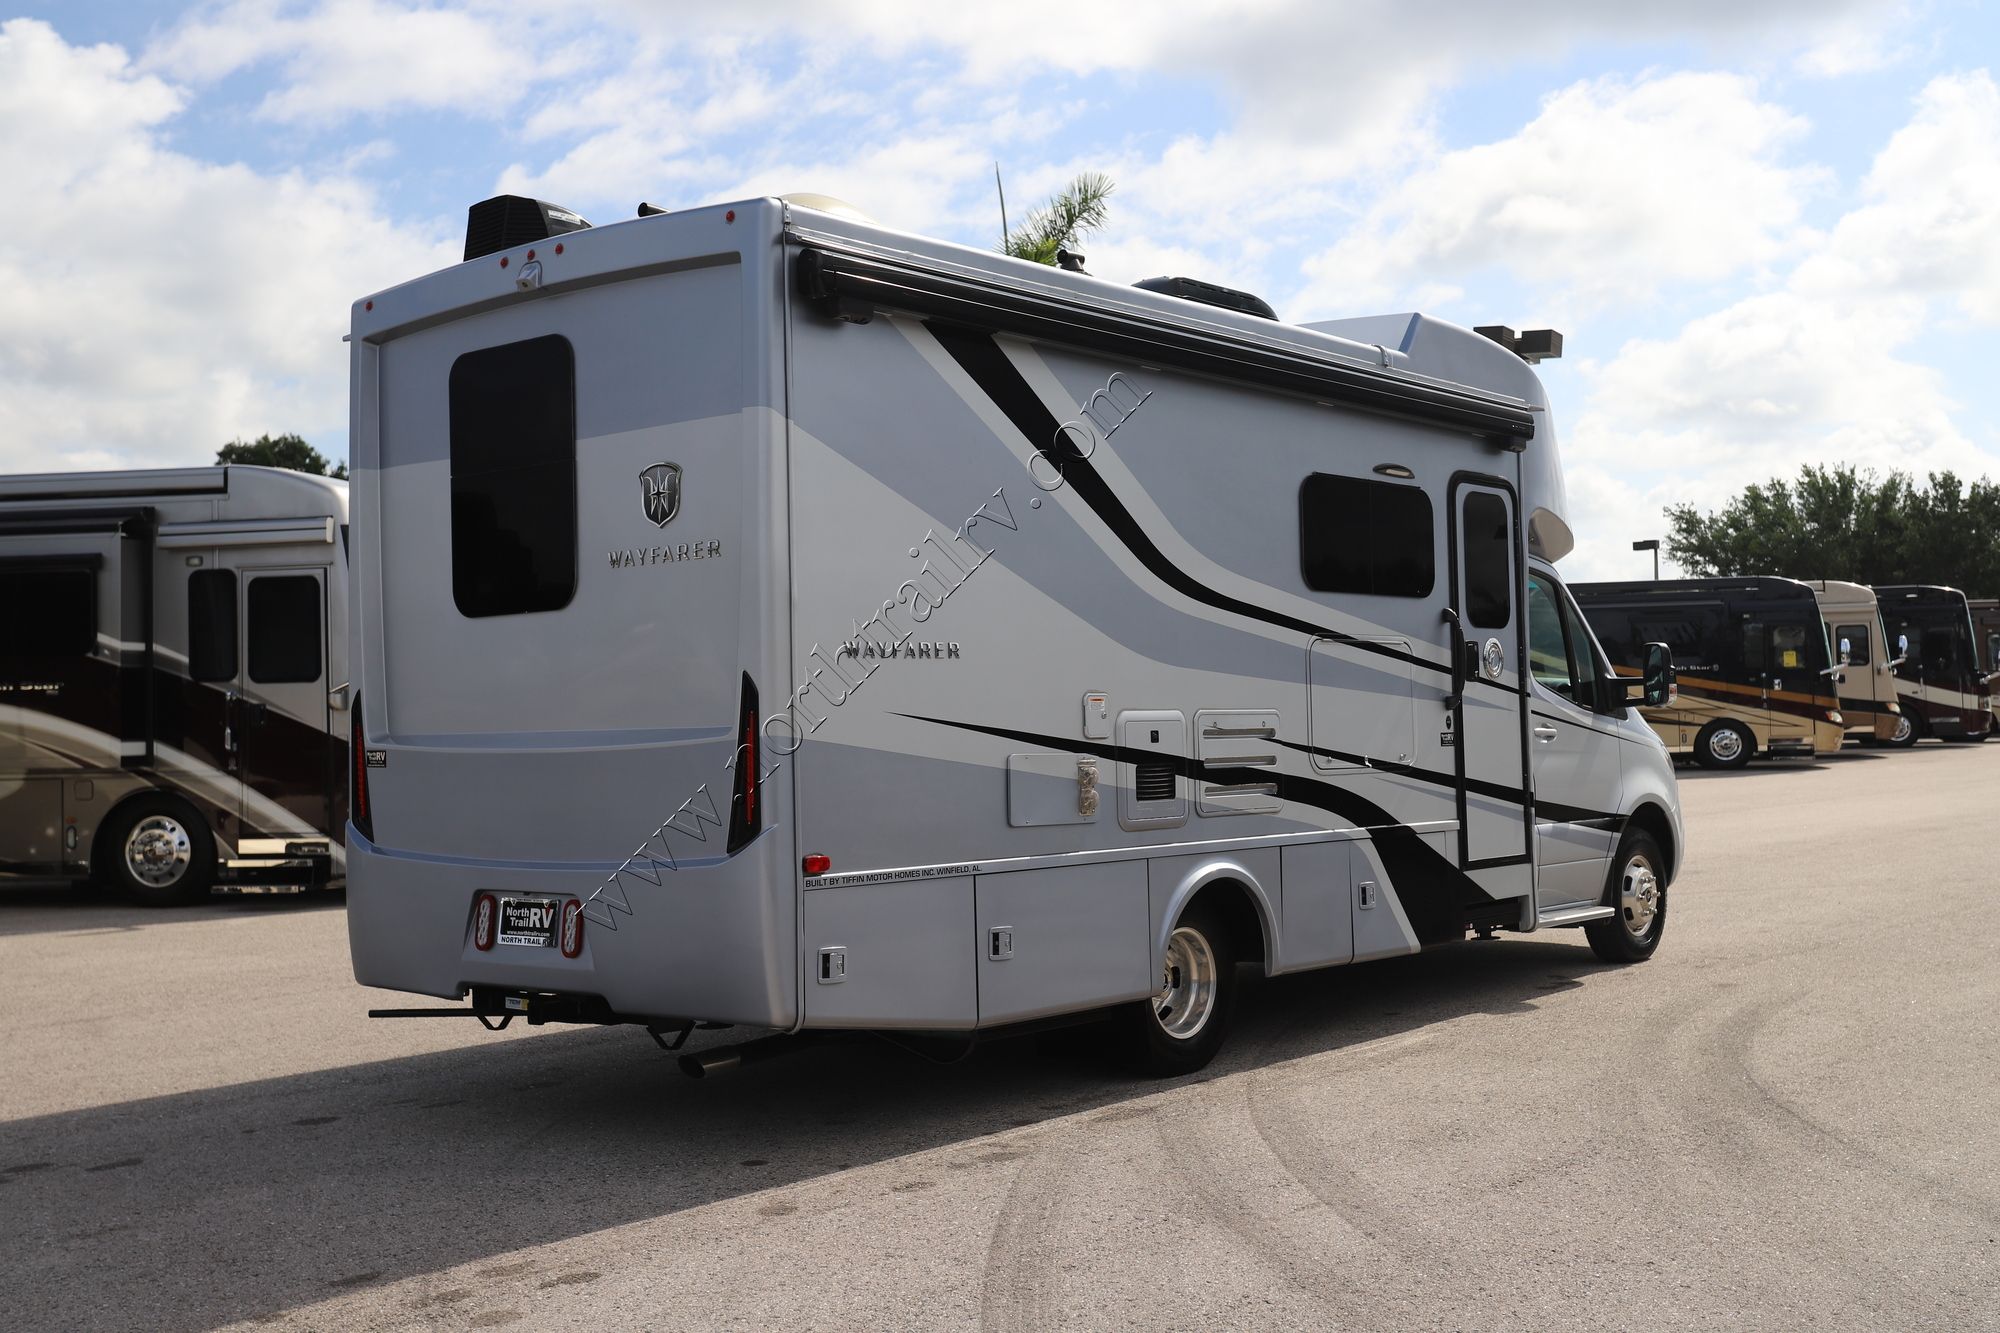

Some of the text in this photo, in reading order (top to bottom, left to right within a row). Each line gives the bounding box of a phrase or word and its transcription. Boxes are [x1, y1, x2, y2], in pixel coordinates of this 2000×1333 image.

[608, 540, 721, 568] WAYFARER
[843, 640, 960, 659] WAYFARER
[377, 752, 386, 761] RV
[805, 878, 828, 888] BUILT
[829, 877, 840, 886] BY
[842, 875, 865, 885] TIFFIN
[866, 872, 893, 882] MOTOR
[894, 870, 920, 879] HOMES
[506, 906, 530, 917] North
[529, 907, 554, 929] RV
[510, 917, 529, 927] Trail
[501, 936, 522, 944] NORTH
[523, 937, 542, 945] TRAIL
